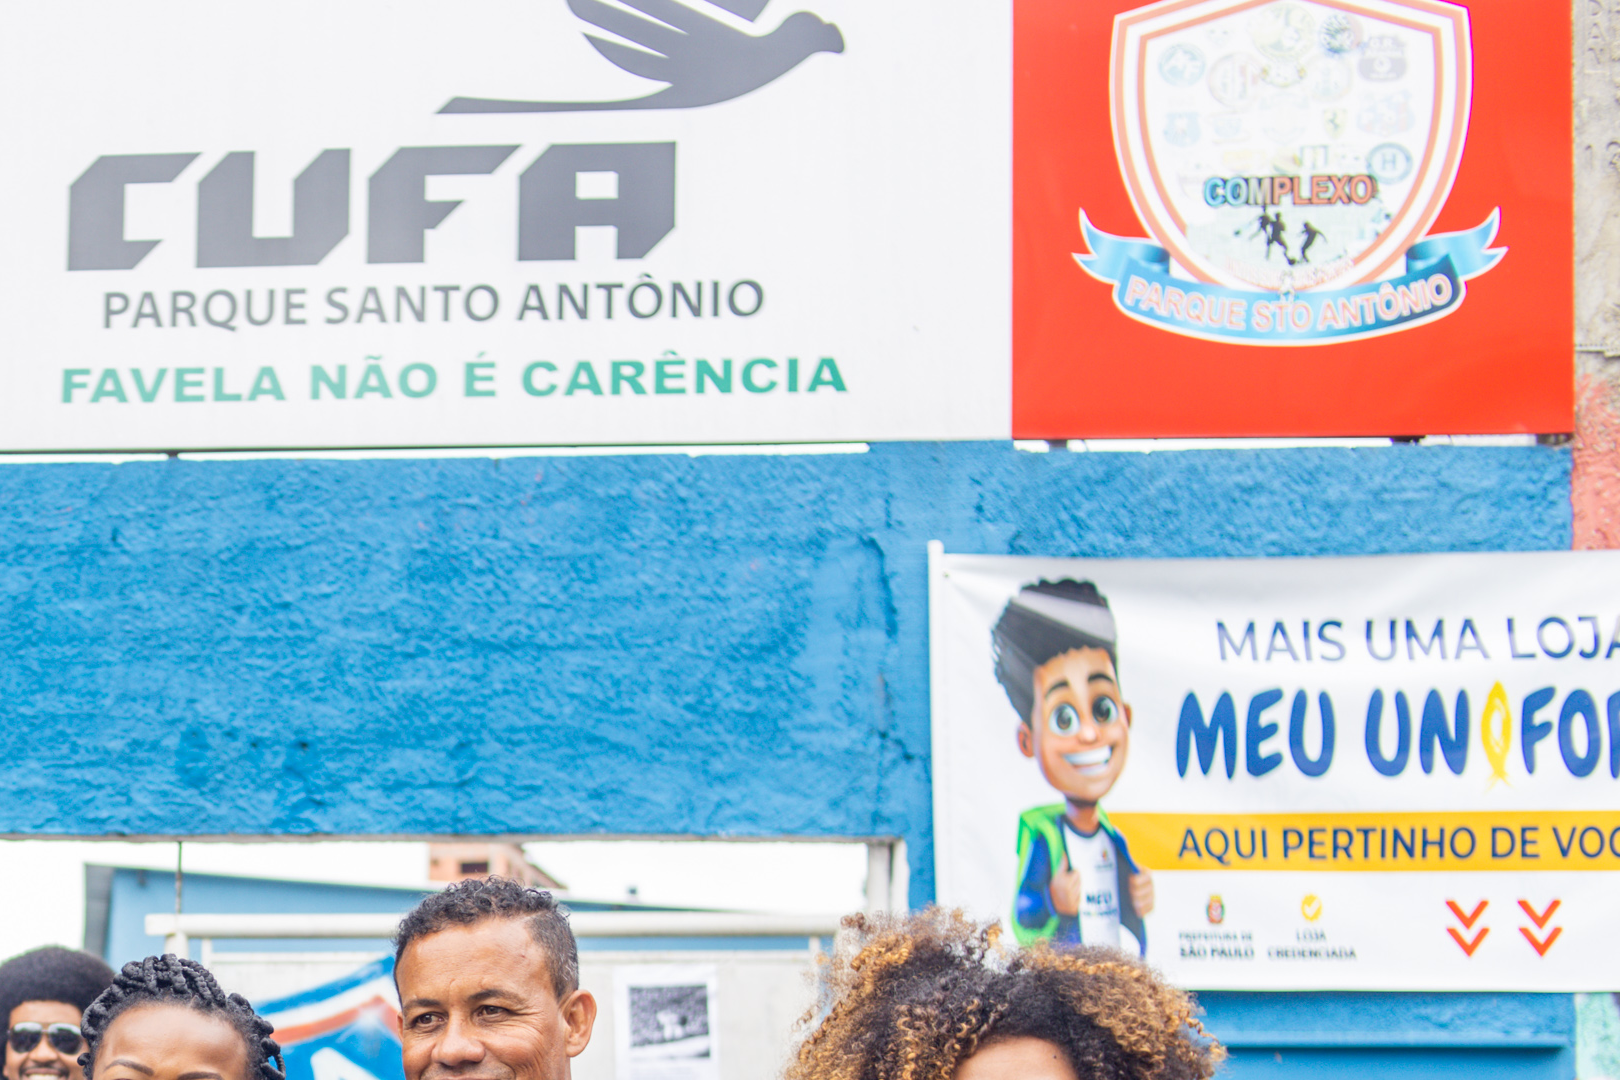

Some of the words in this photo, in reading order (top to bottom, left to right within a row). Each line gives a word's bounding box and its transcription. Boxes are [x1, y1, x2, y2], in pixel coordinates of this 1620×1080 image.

[66, 141, 677, 271] CUFA
[1204, 175, 1378, 207] COMPLEXO
[103, 287, 307, 332] PARQUE
[325, 284, 500, 325] SANTO
[517, 273, 764, 322] ANTÔNIO
[1125, 274, 1247, 331] PARQUE
[1253, 300, 1311, 332] STO
[1317, 272, 1453, 331] ANTÔNIO
[61, 367, 286, 403] FAVELA
[309, 355, 437, 401] NÃO
[463, 351, 497, 398] É
[521, 350, 848, 397] CARÊNCIA
[1217, 619, 1346, 662] MAIS
[1364, 617, 1490, 661] UMA
[1176, 687, 1336, 780] MEU
[1178, 827, 1269, 866] AQUI
[1283, 826, 1476, 861] PERTINHO
[1491, 826, 1539, 859] DE
[1552, 825, 1620, 858] VO
